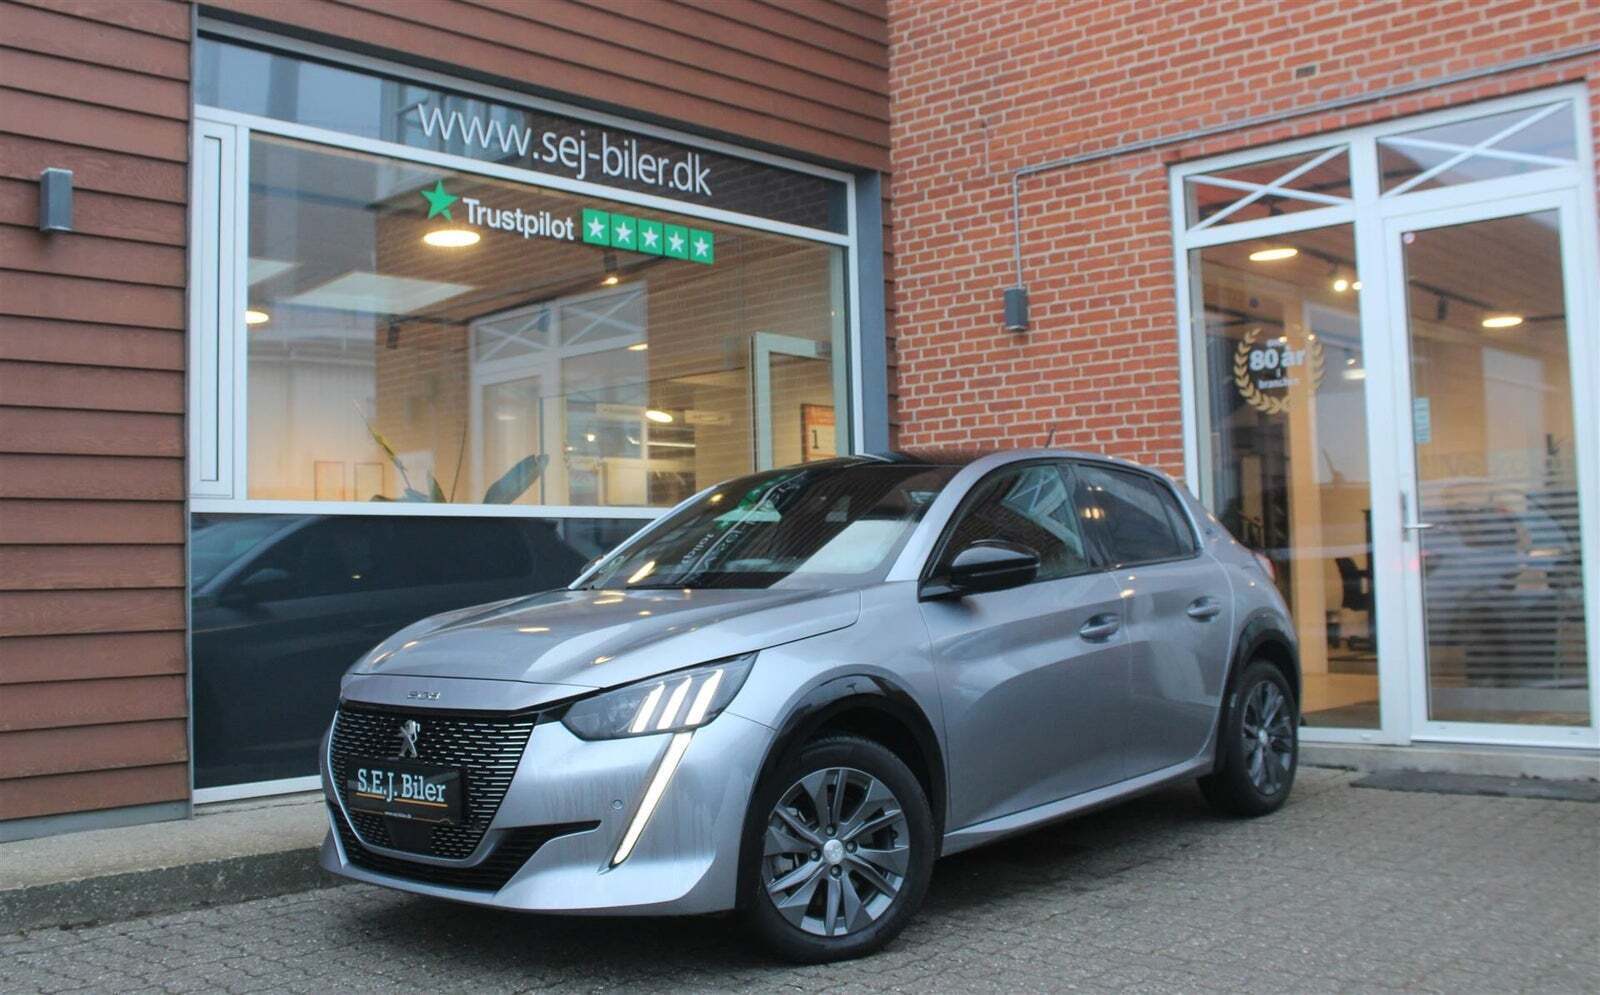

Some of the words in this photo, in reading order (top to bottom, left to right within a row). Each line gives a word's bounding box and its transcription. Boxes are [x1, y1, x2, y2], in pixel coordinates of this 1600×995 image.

[417, 103, 712, 196] www.sej-biler.dk
[462, 197, 575, 241] Trustpilot
[1249, 349, 1279, 371] 80
[811, 429, 819, 449] 1
[357, 768, 398, 802] S.E.J.
[401, 773, 446, 802] Biler
